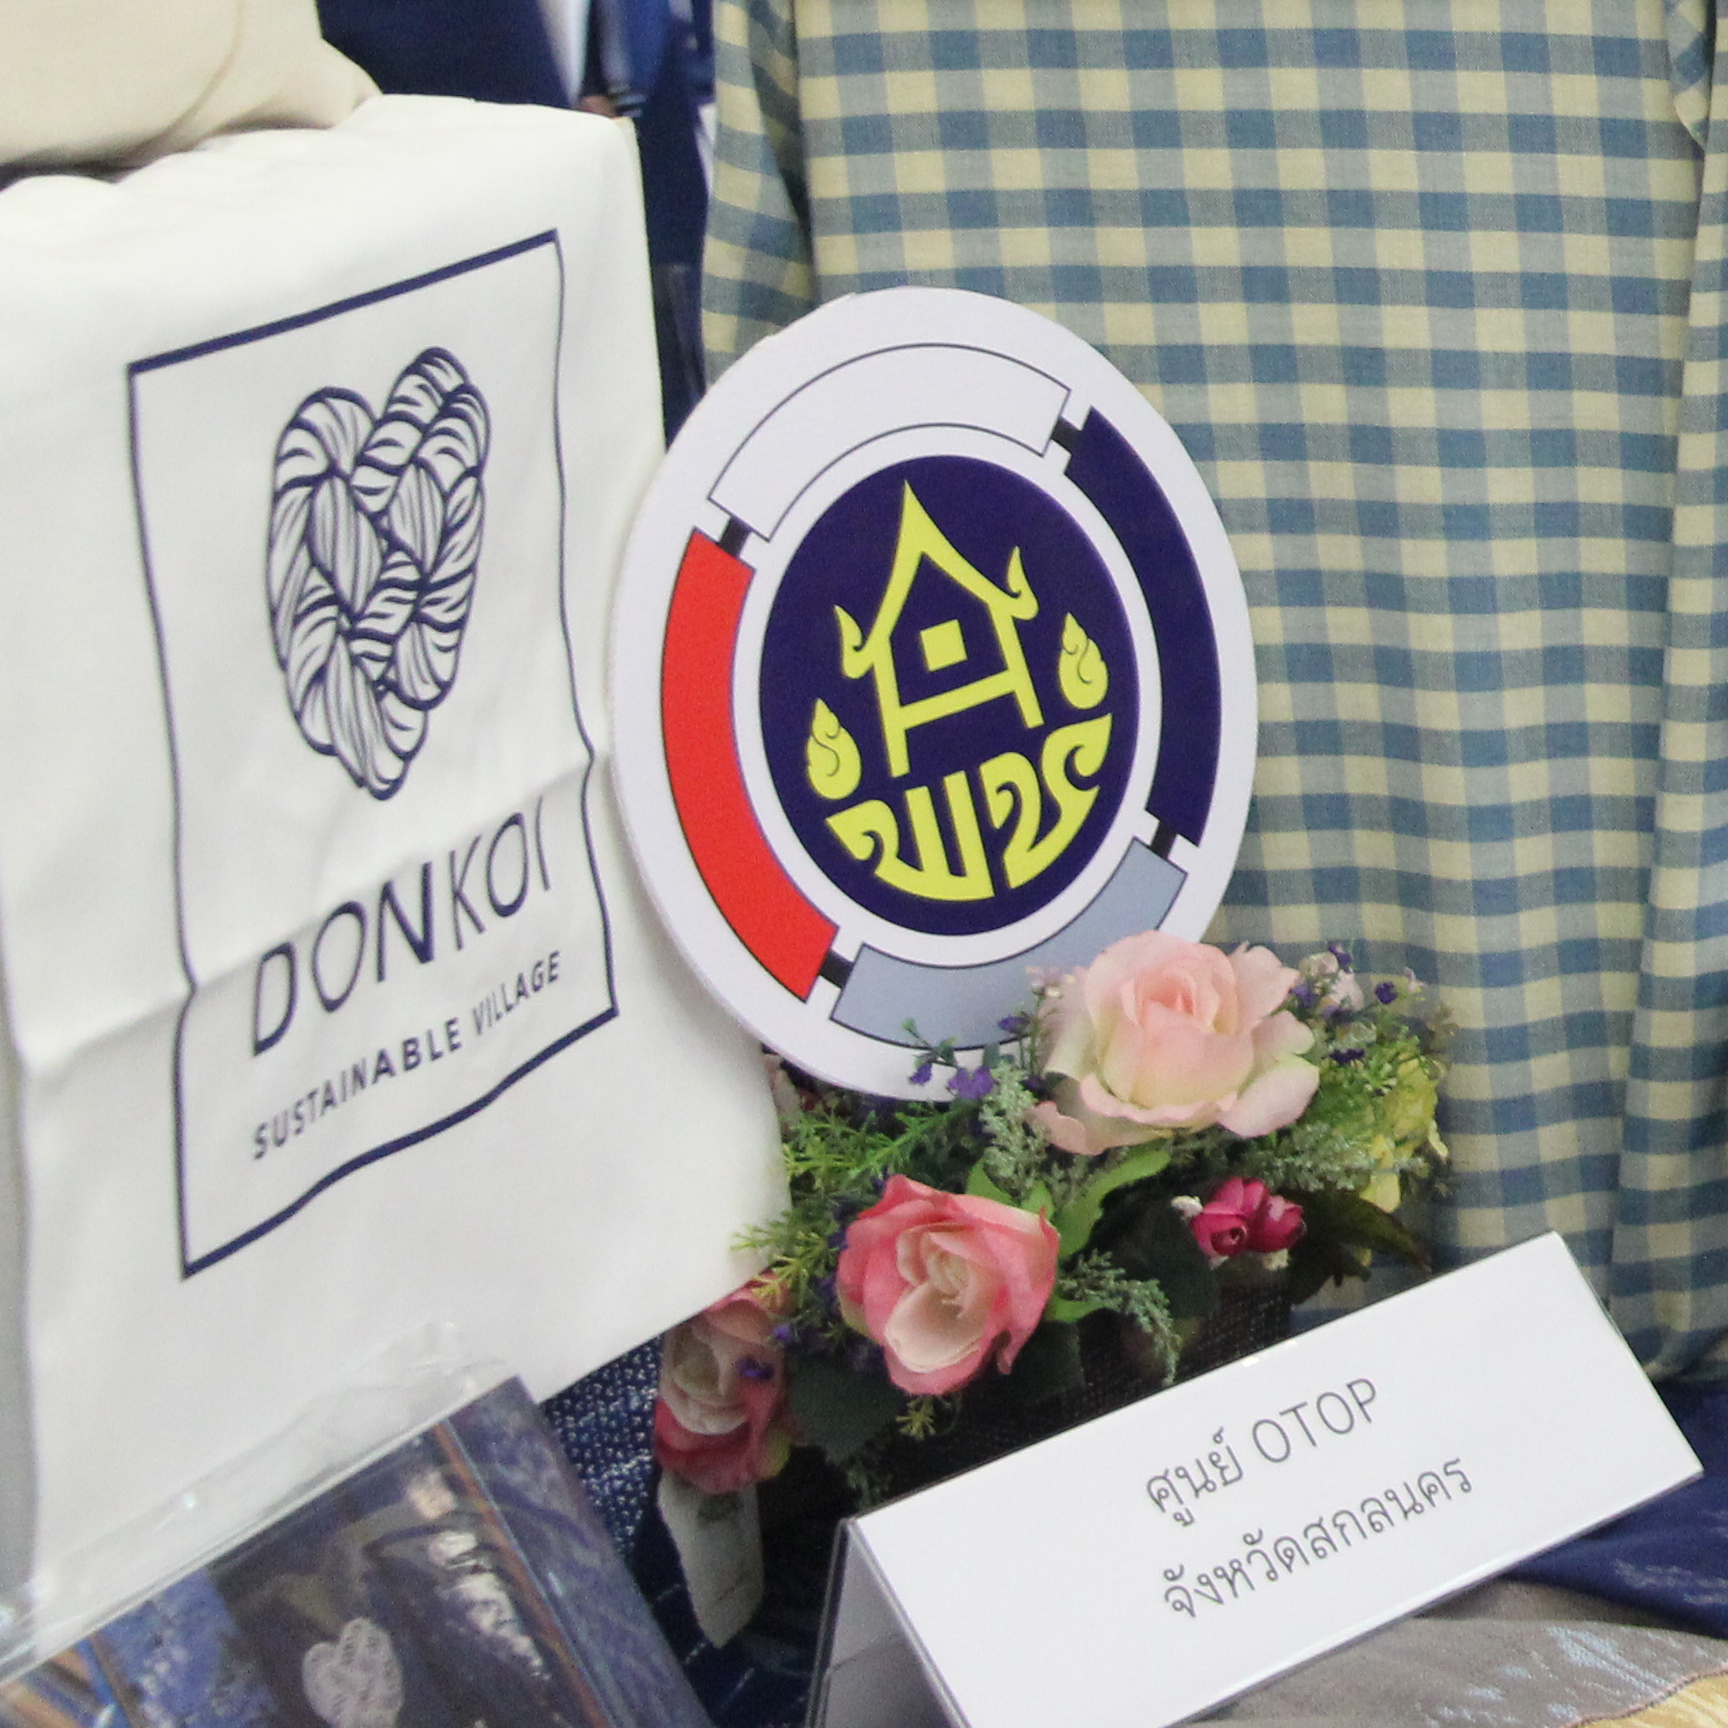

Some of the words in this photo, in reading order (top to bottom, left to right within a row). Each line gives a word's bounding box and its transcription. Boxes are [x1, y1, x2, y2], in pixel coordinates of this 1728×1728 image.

[252, 795, 551, 1058] DONKOI
[252, 1017, 464, 1161] SUSTAINABLE
[471, 950, 561, 1036] VILLAGE
[1146, 1426, 1245, 1527] ศูนย์
[1251, 1377, 1377, 1463] OTOP
[1163, 1457, 1474, 1619] จังหวัดสกลนคร
